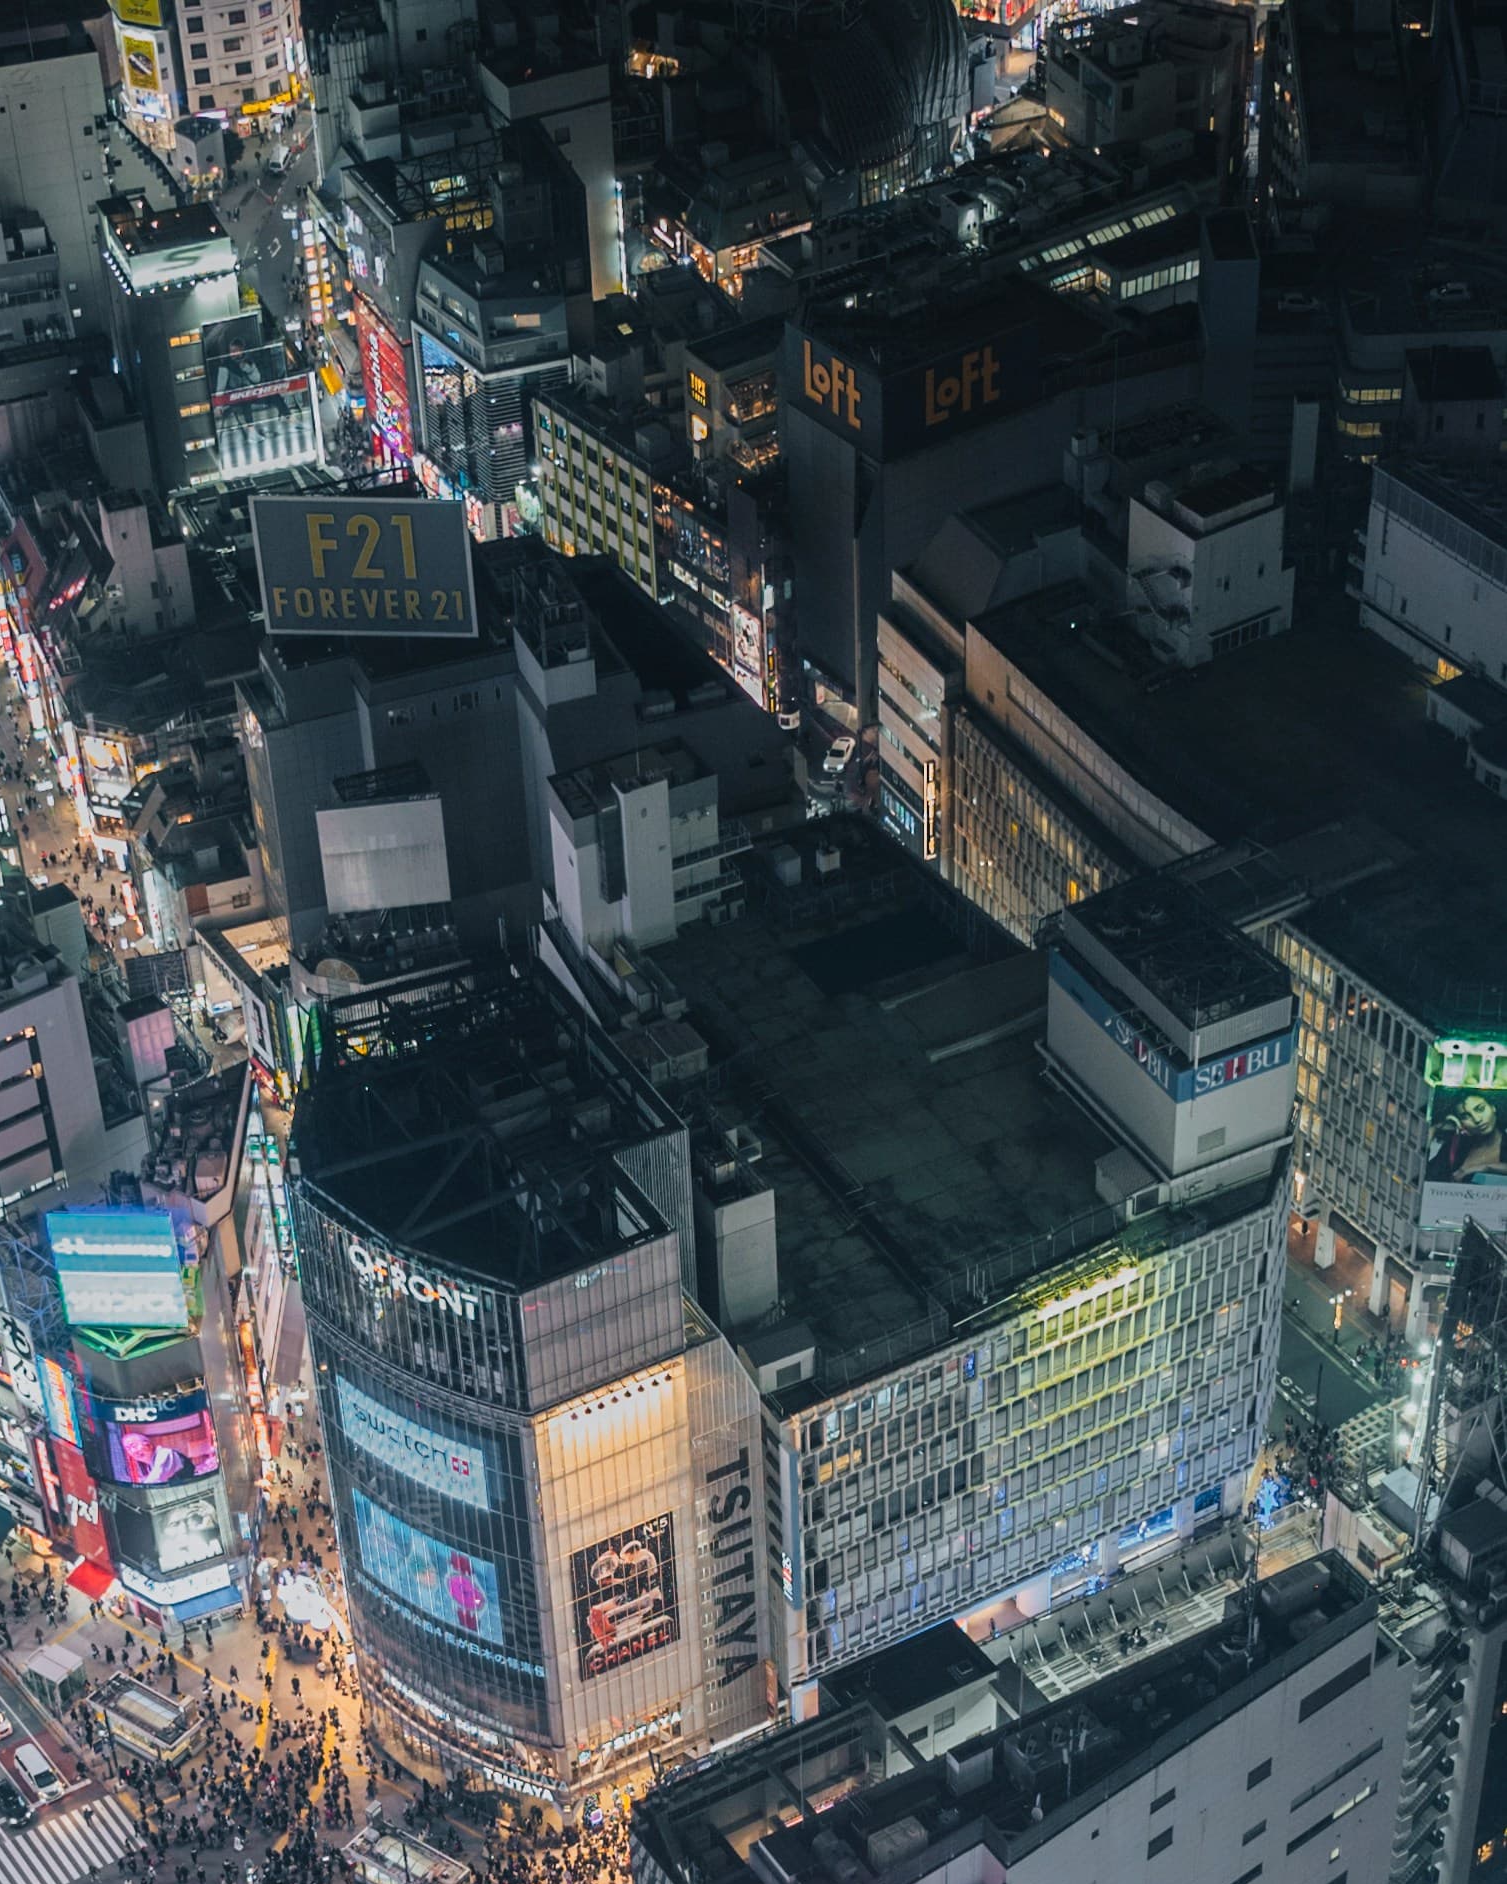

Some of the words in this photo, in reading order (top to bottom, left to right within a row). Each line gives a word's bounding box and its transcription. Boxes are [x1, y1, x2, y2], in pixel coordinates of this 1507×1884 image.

[229, 382, 290, 402] SKECHERS
[306, 513, 418, 580] F21
[272, 587, 422, 621] FOREVER
[430, 591, 465, 621] 21
[1194, 1042, 1282, 1094] SEIBU
[114, 1406, 158, 1423] DHC
[706, 1446, 760, 1690] TSUTAYA
[589, 1630, 670, 1672] CHANEL
[601, 1711, 682, 1760] TSUTAYA
[482, 1766, 555, 1802] TSUTAYA
